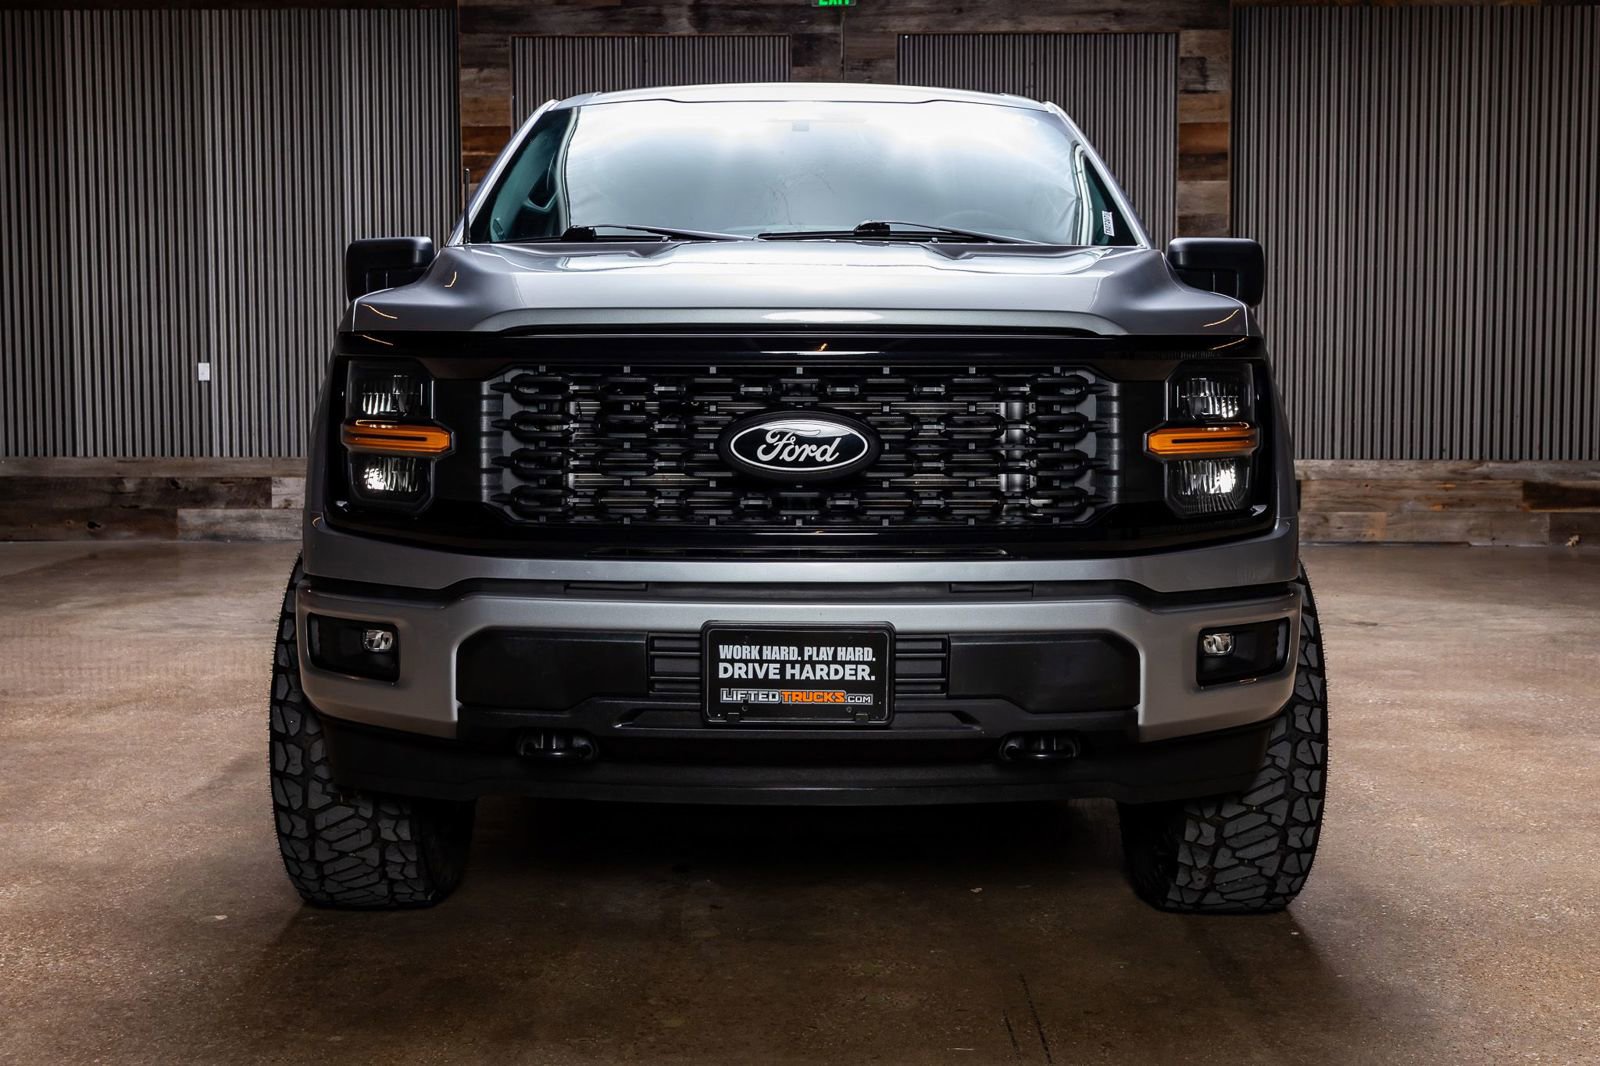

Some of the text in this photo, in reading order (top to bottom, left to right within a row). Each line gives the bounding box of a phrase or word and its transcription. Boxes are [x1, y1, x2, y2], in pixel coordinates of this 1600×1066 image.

[757, 428, 842, 462] Ford
[719, 644, 876, 662] WORK HARD. PLAY HARD.
[718, 662, 876, 681] DRIVE HARDER.
